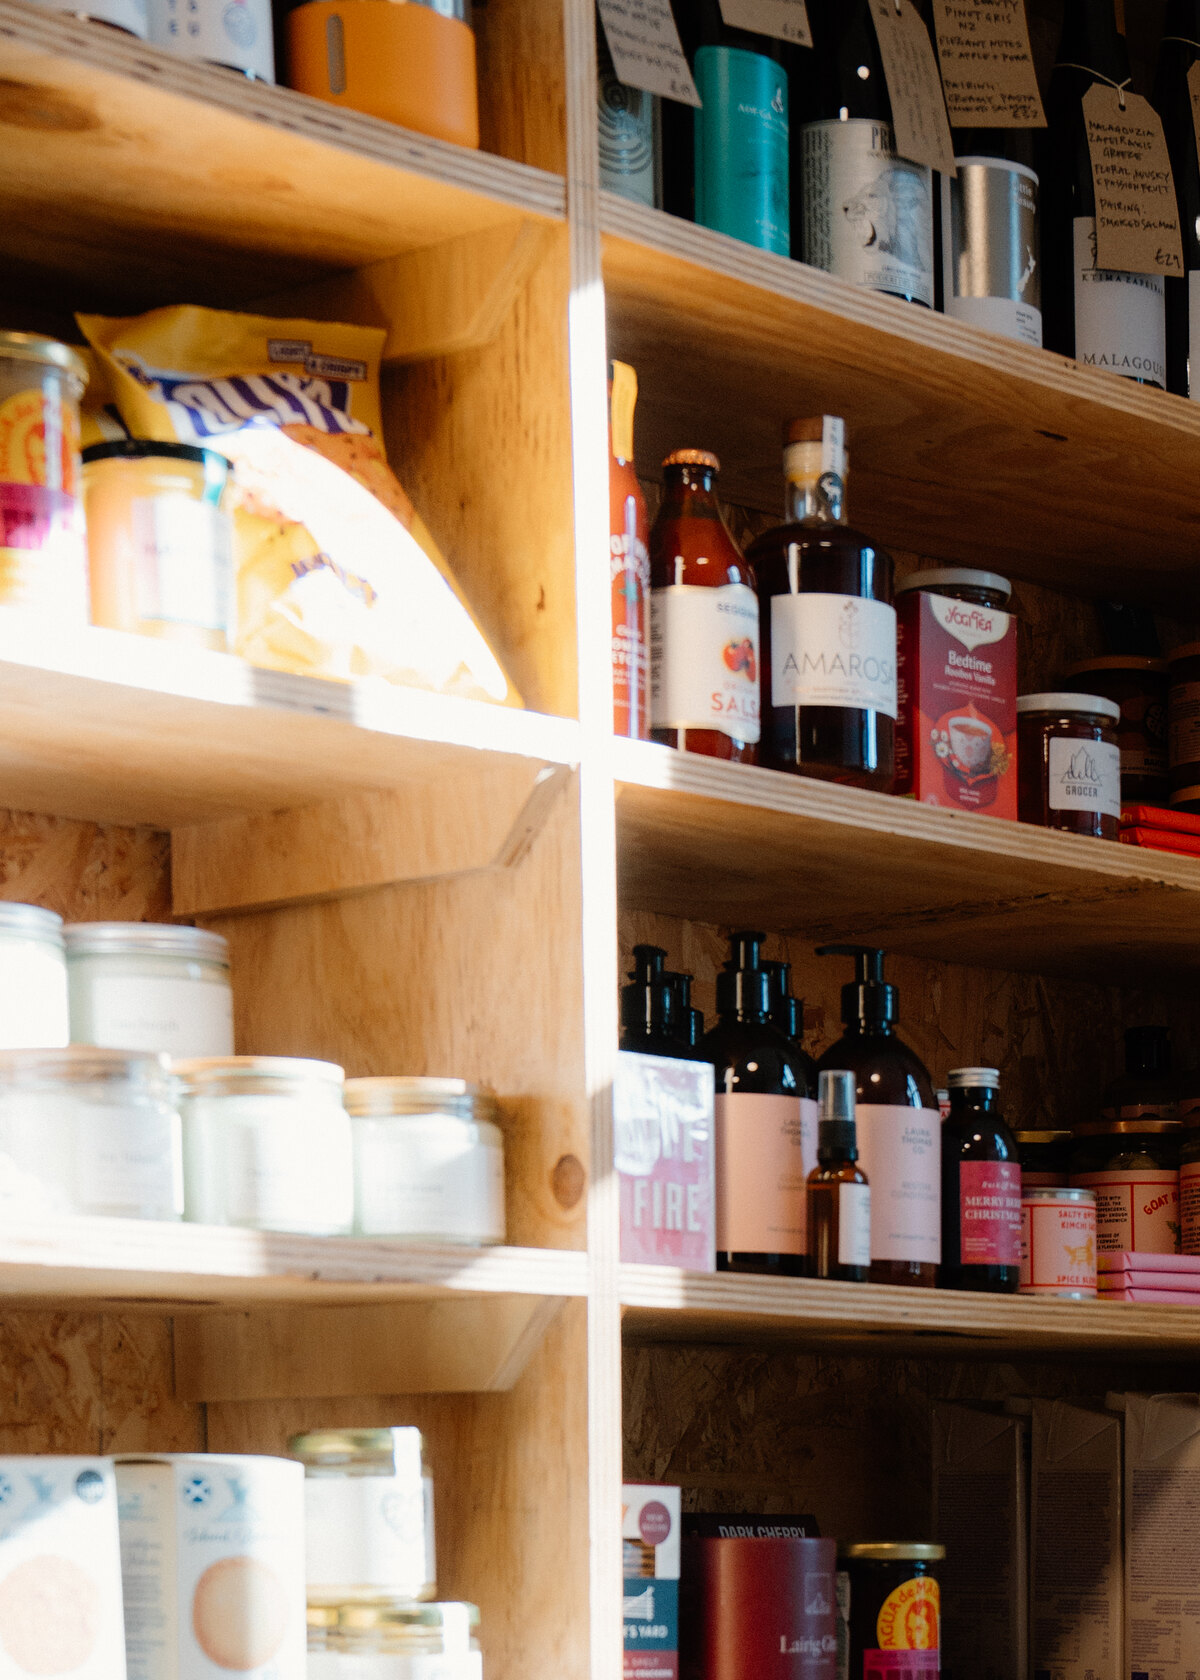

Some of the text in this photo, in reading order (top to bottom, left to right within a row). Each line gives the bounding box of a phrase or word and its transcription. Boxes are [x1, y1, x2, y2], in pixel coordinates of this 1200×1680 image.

[948, 650, 992, 674] Bedtime
[1065, 785, 1098, 799] GROCER
[632, 1179, 700, 1232] FIRE
[965, 1196, 1004, 1206] MERRY
[1143, 1194, 1169, 1215] GOAT
[1058, 1210, 1081, 1219] SALTY
[718, 1525, 806, 1538] DARK CHERRY
[639, 1624, 669, 1639] YARD
